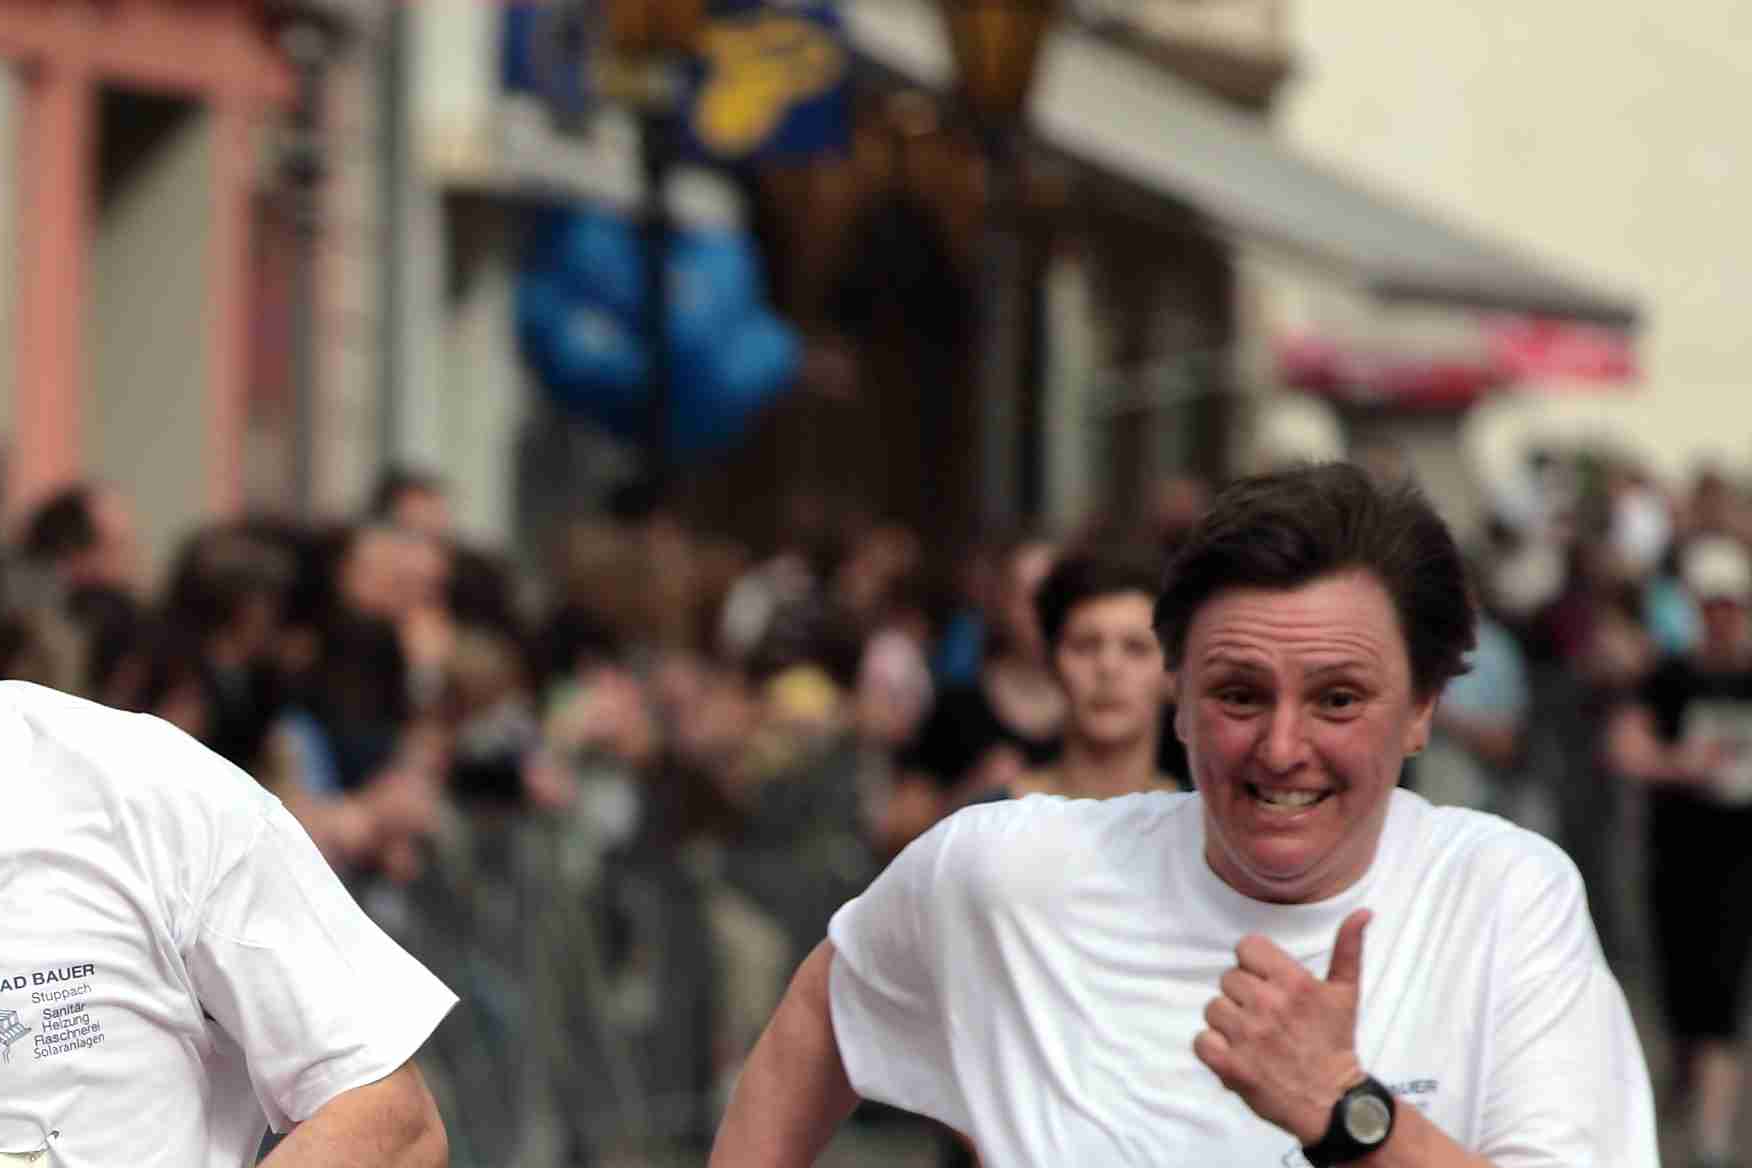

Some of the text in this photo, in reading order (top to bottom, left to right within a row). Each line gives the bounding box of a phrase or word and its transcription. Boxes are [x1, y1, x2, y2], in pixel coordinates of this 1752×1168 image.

[31, 963, 96, 986] BAUER
[31, 983, 93, 1004] Stuppach
[42, 1002, 87, 1020] Sanitär
[33, 1021, 101, 1047] Flaschnerei
[42, 1013, 90, 1033] Heizung
[33, 1033, 105, 1059] Solaranlagen
